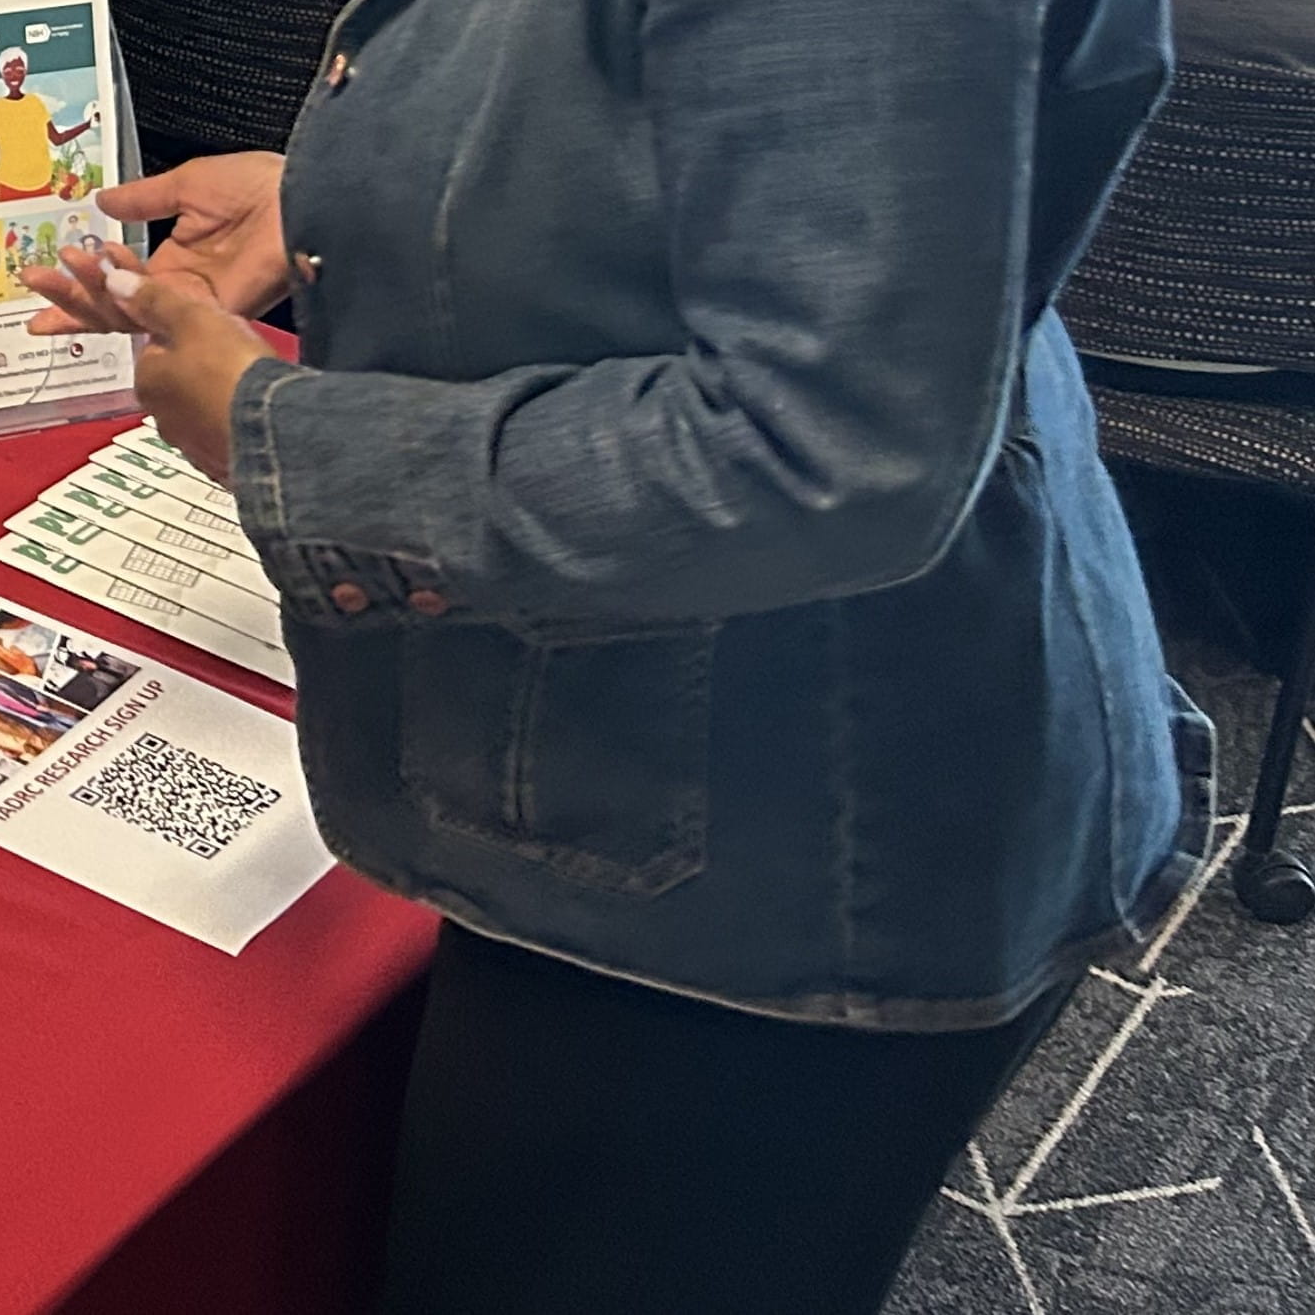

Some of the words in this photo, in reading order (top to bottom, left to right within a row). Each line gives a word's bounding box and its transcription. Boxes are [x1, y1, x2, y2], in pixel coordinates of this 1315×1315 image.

[33, 727, 114, 787] RESEARCH
[103, 697, 147, 731] SIGN
[139, 679, 167, 701] UP
